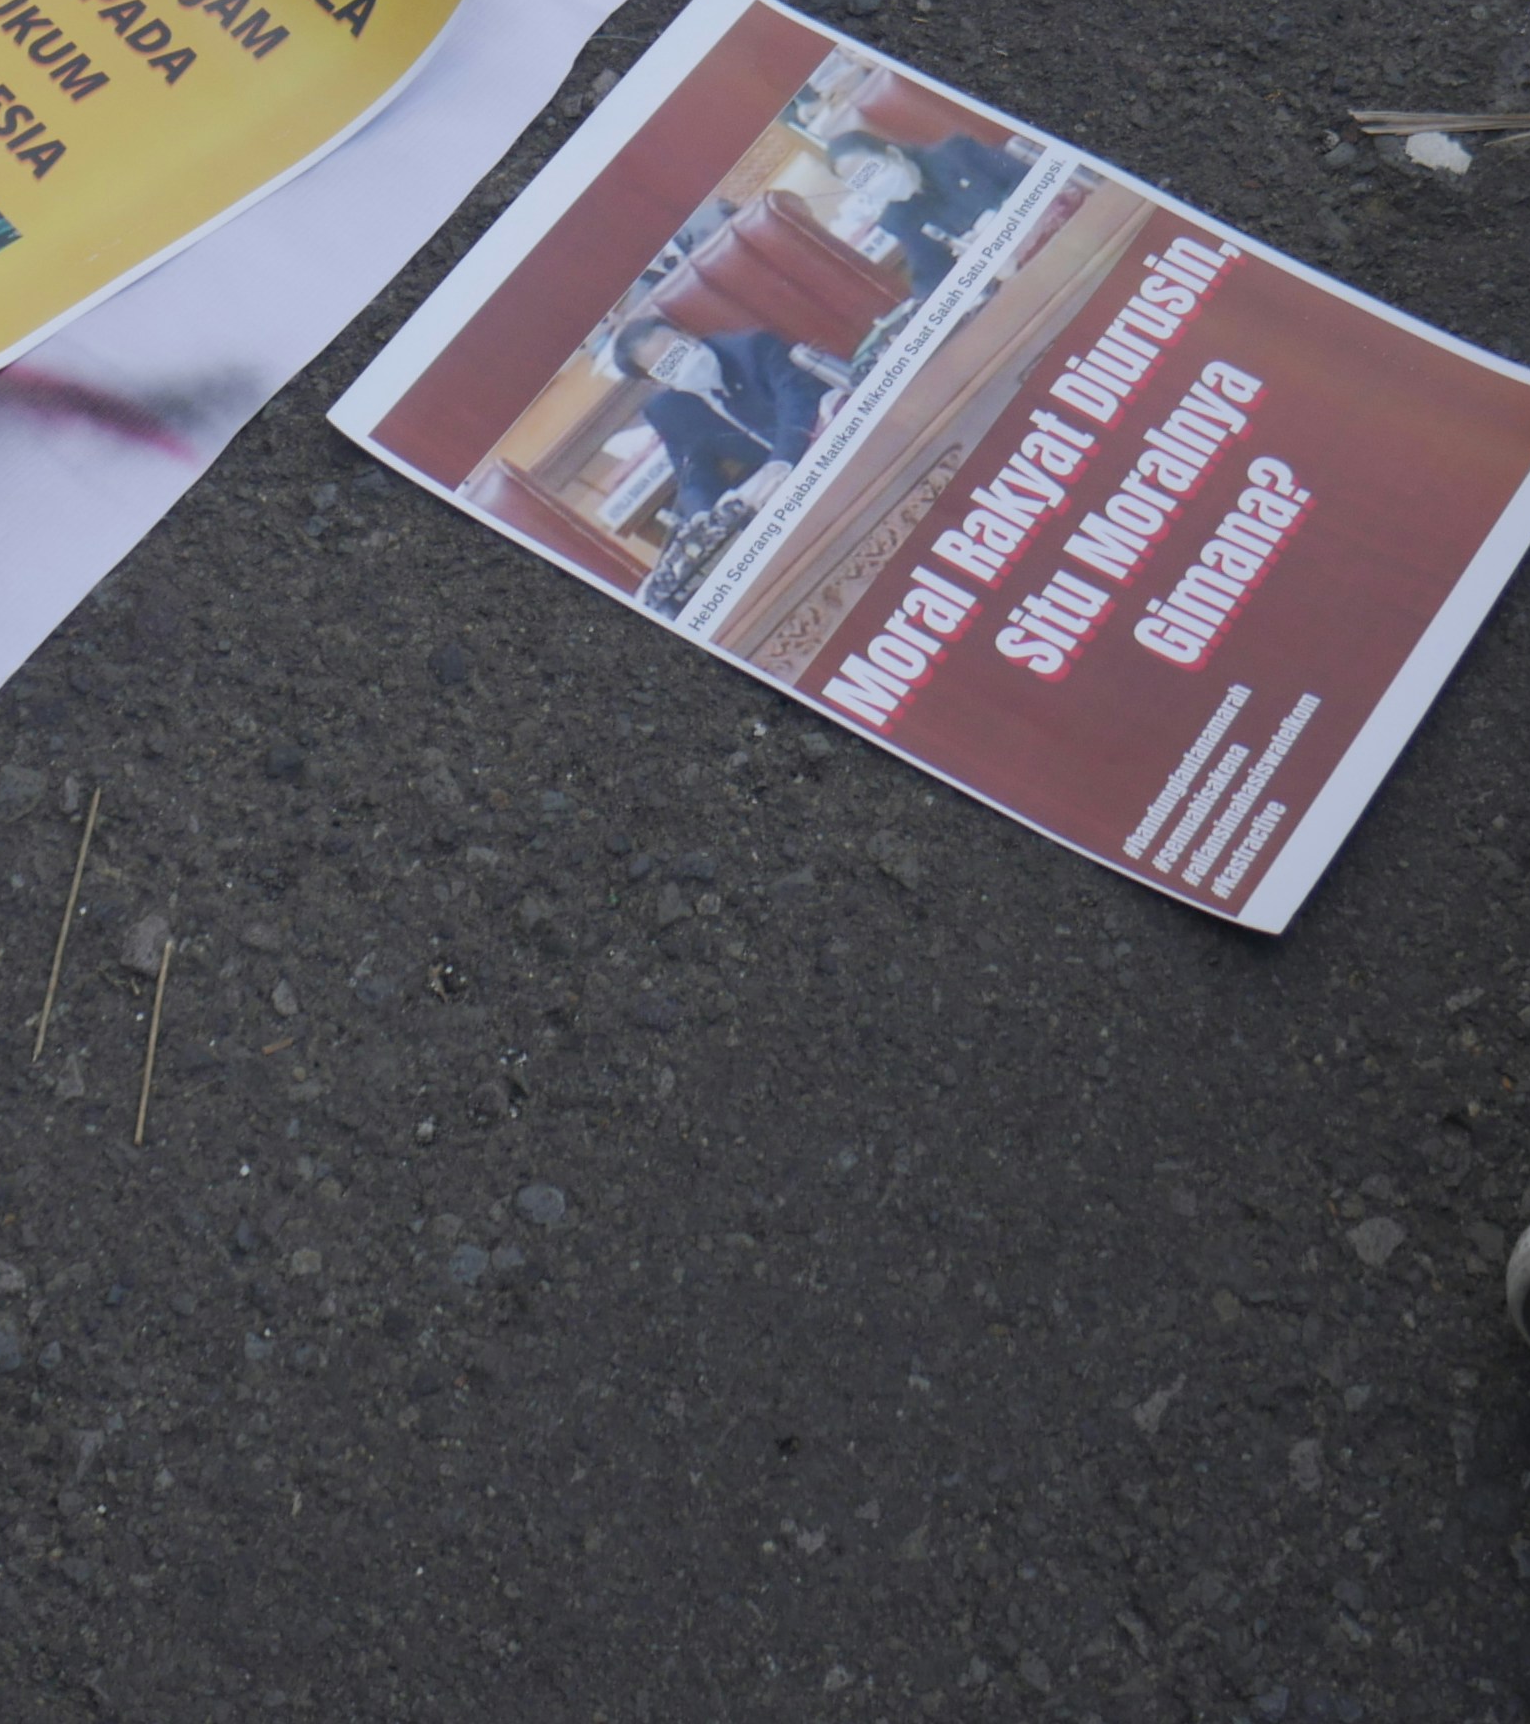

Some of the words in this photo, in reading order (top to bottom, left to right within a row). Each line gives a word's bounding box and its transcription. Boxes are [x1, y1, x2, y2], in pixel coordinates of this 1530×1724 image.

[684, 580, 735, 634] Heboh
[722, 518, 785, 586] Seorang
[770, 465, 827, 525] Pejabat
[811, 412, 867, 472] Matikan
[853, 352, 914, 418] Mikrofon
[900, 322, 937, 358] Saat
[925, 285, 966, 327] Salah
[954, 255, 990, 290] Satu
[978, 214, 1025, 261] Parpol
[1009, 153, 1072, 220] Interupsi.
[821, 564, 976, 727] Moral
[930, 408, 1095, 582] Rakyat
[1048, 225, 1249, 423] Diurusin,
[994, 569, 1110, 674] Situ
[1062, 359, 1262, 580] Moralnya
[1133, 455, 1310, 664] Gimana?
[1121, 683, 1252, 860] #bandunglautanamarah
[1151, 742, 1250, 874] #semuabisakena
[1180, 692, 1321, 887] #aliansimahasiswatelkom
[1209, 799, 1287, 900] #kastractive
